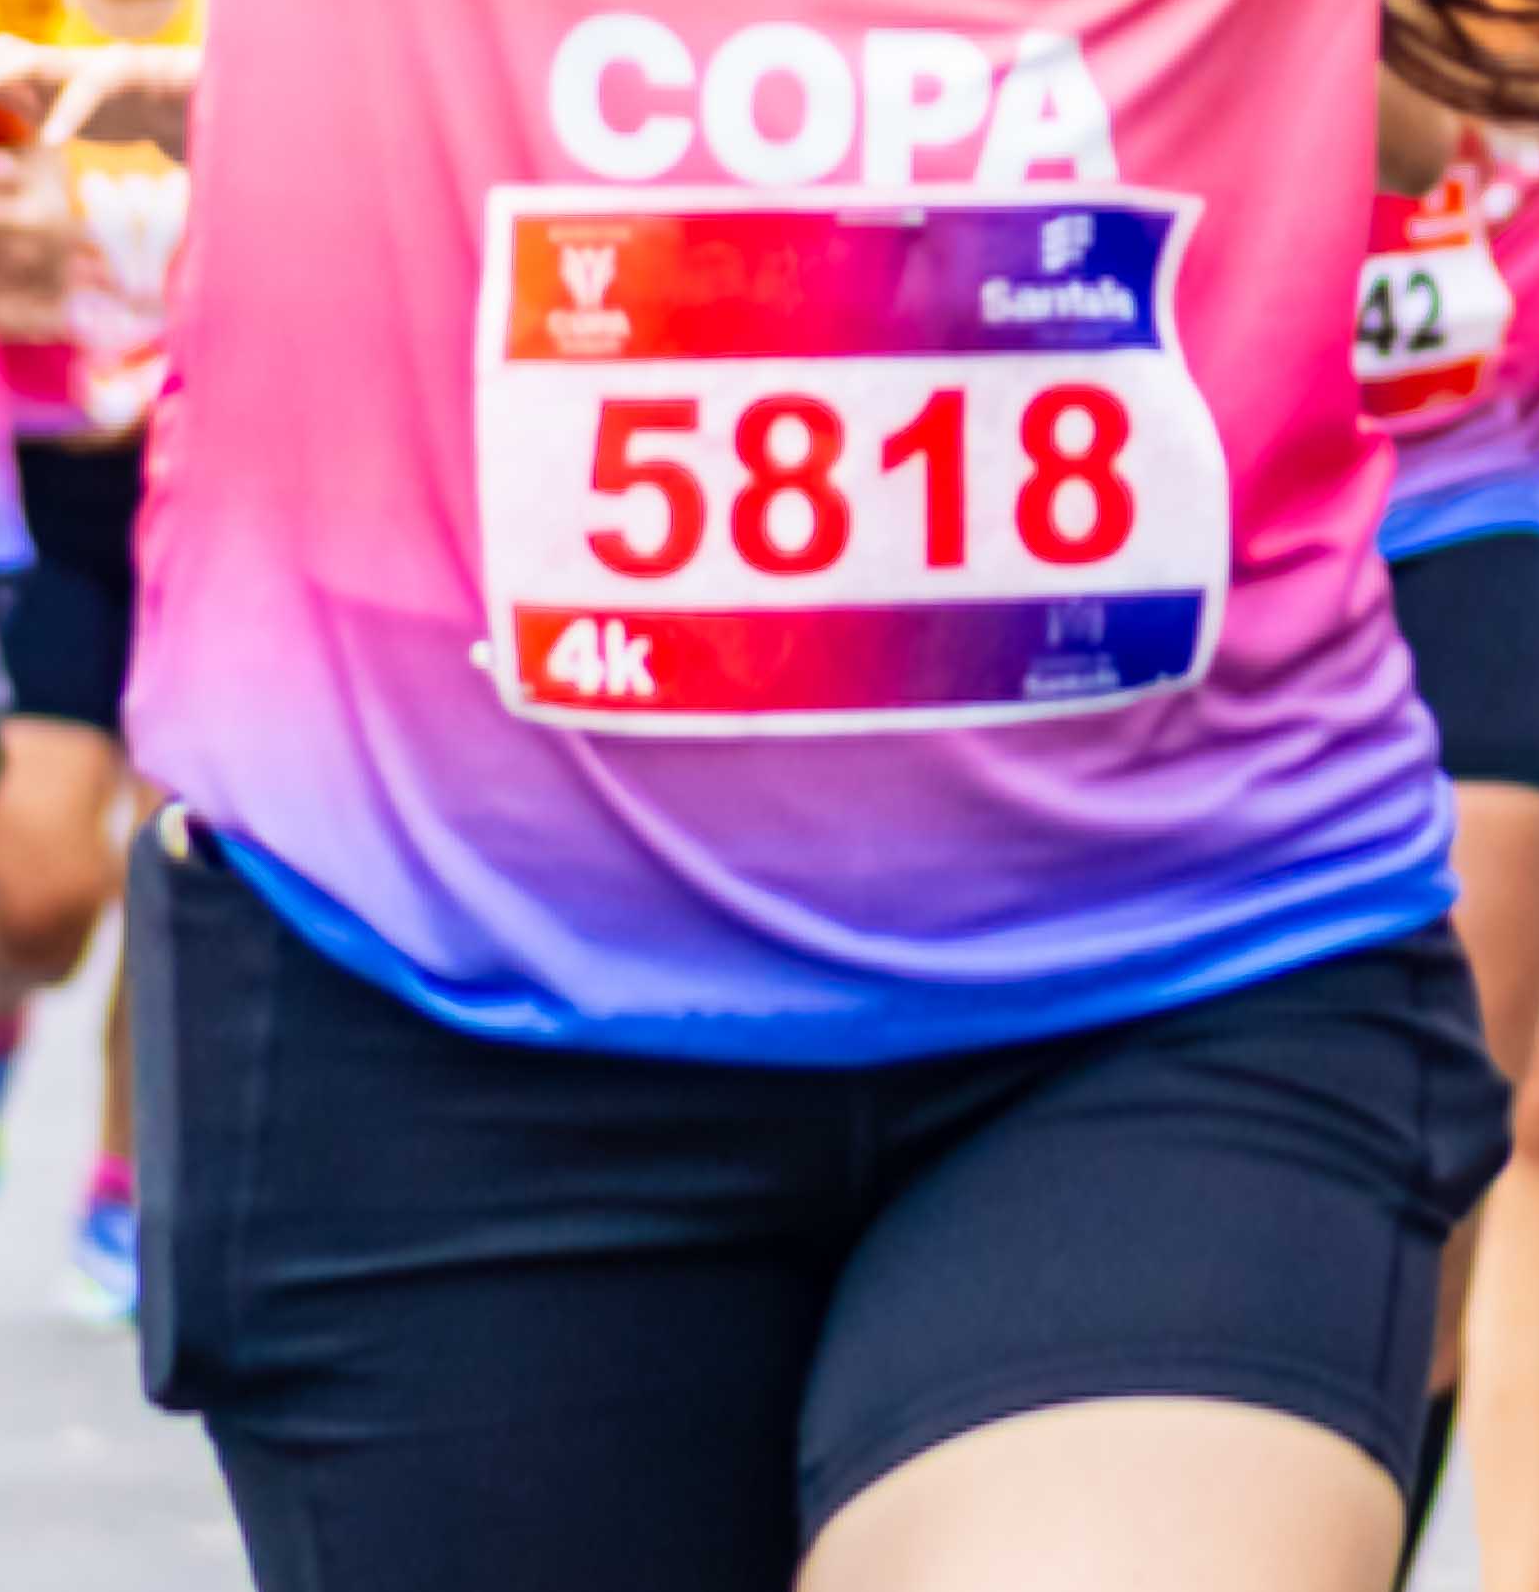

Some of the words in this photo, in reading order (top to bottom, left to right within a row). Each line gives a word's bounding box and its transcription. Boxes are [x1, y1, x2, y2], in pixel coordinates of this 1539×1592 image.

[549, 13, 1121, 184] COPA
[587, 384, 1136, 579] 5818
[547, 617, 655, 697] 4k
